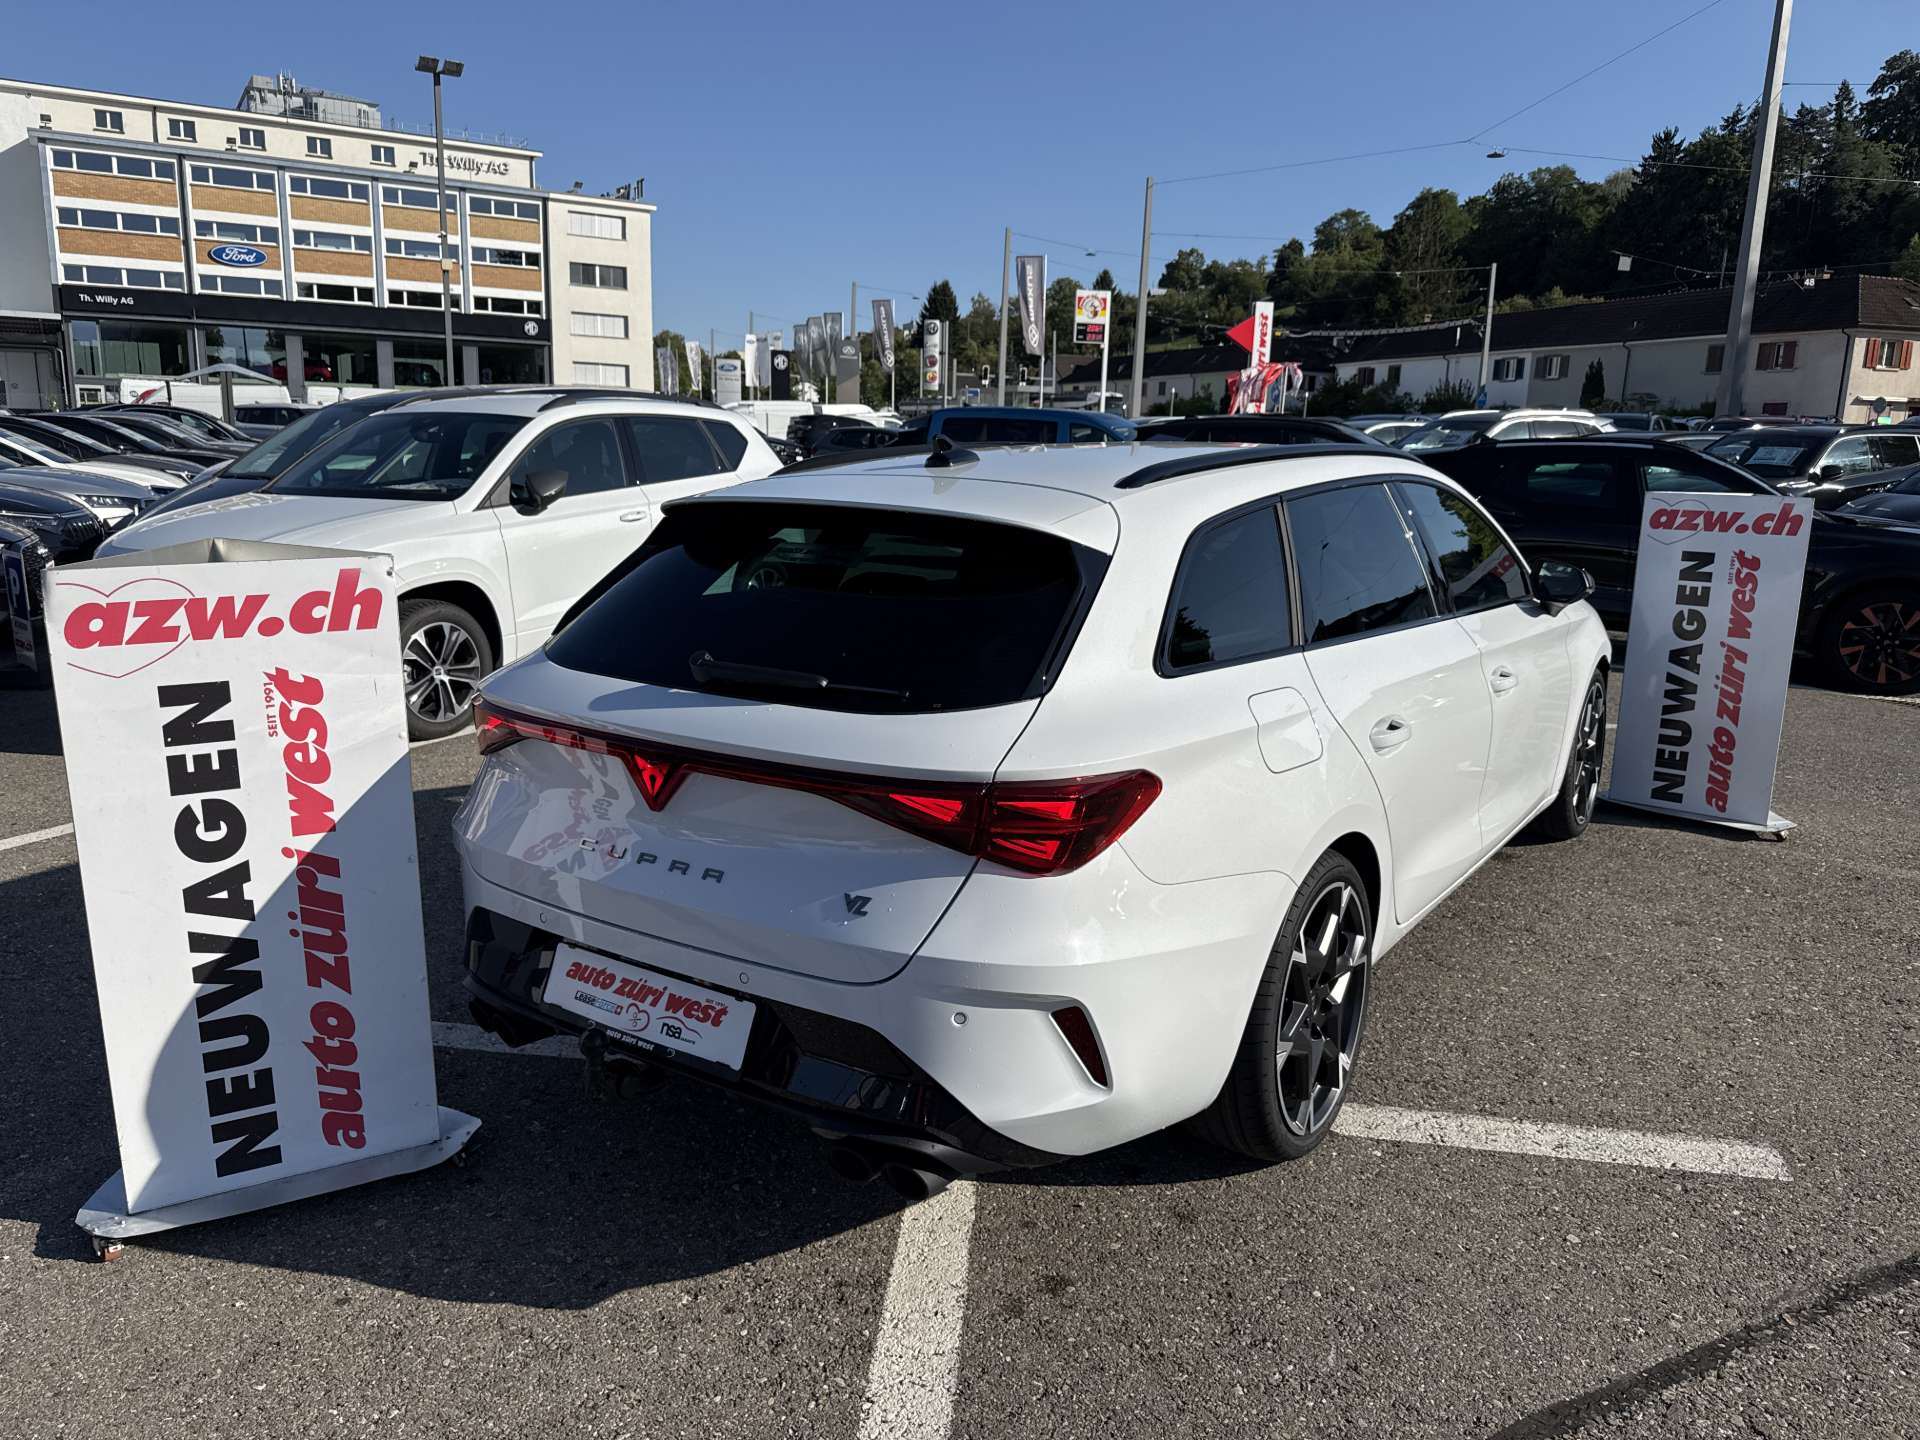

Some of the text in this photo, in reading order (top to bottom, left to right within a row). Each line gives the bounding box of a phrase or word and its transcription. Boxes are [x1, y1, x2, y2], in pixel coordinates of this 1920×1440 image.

[447, 154, 483, 175] Willy
[484, 161, 509, 176] AG
[221, 247, 257, 263] Ford
[1804, 278, 1815, 287] 48
[78, 293, 134, 306] Th. Willy AG
[773, 354, 788, 370] MG
[1649, 503, 1804, 536] azw.ch
[63, 568, 382, 649] azw.ch
[1650, 550, 1716, 805] NEUWAGEN
[1706, 549, 1761, 813] auto züri west
[263, 682, 279, 737] SEIT 1991
[578, 837, 726, 884] CUPRA
[262, 666, 367, 1150] auto züri west
[843, 892, 873, 917] VZ
[157, 680, 283, 1178] NEUWAGEN
[565, 961, 617, 991] auto
[612, 977, 668, 1007] züri
[664, 993, 729, 1027] west
[605, 1028, 622, 1040] auto
[636, 1039, 655, 1051] west
[659, 1021, 682, 1040] nsa
